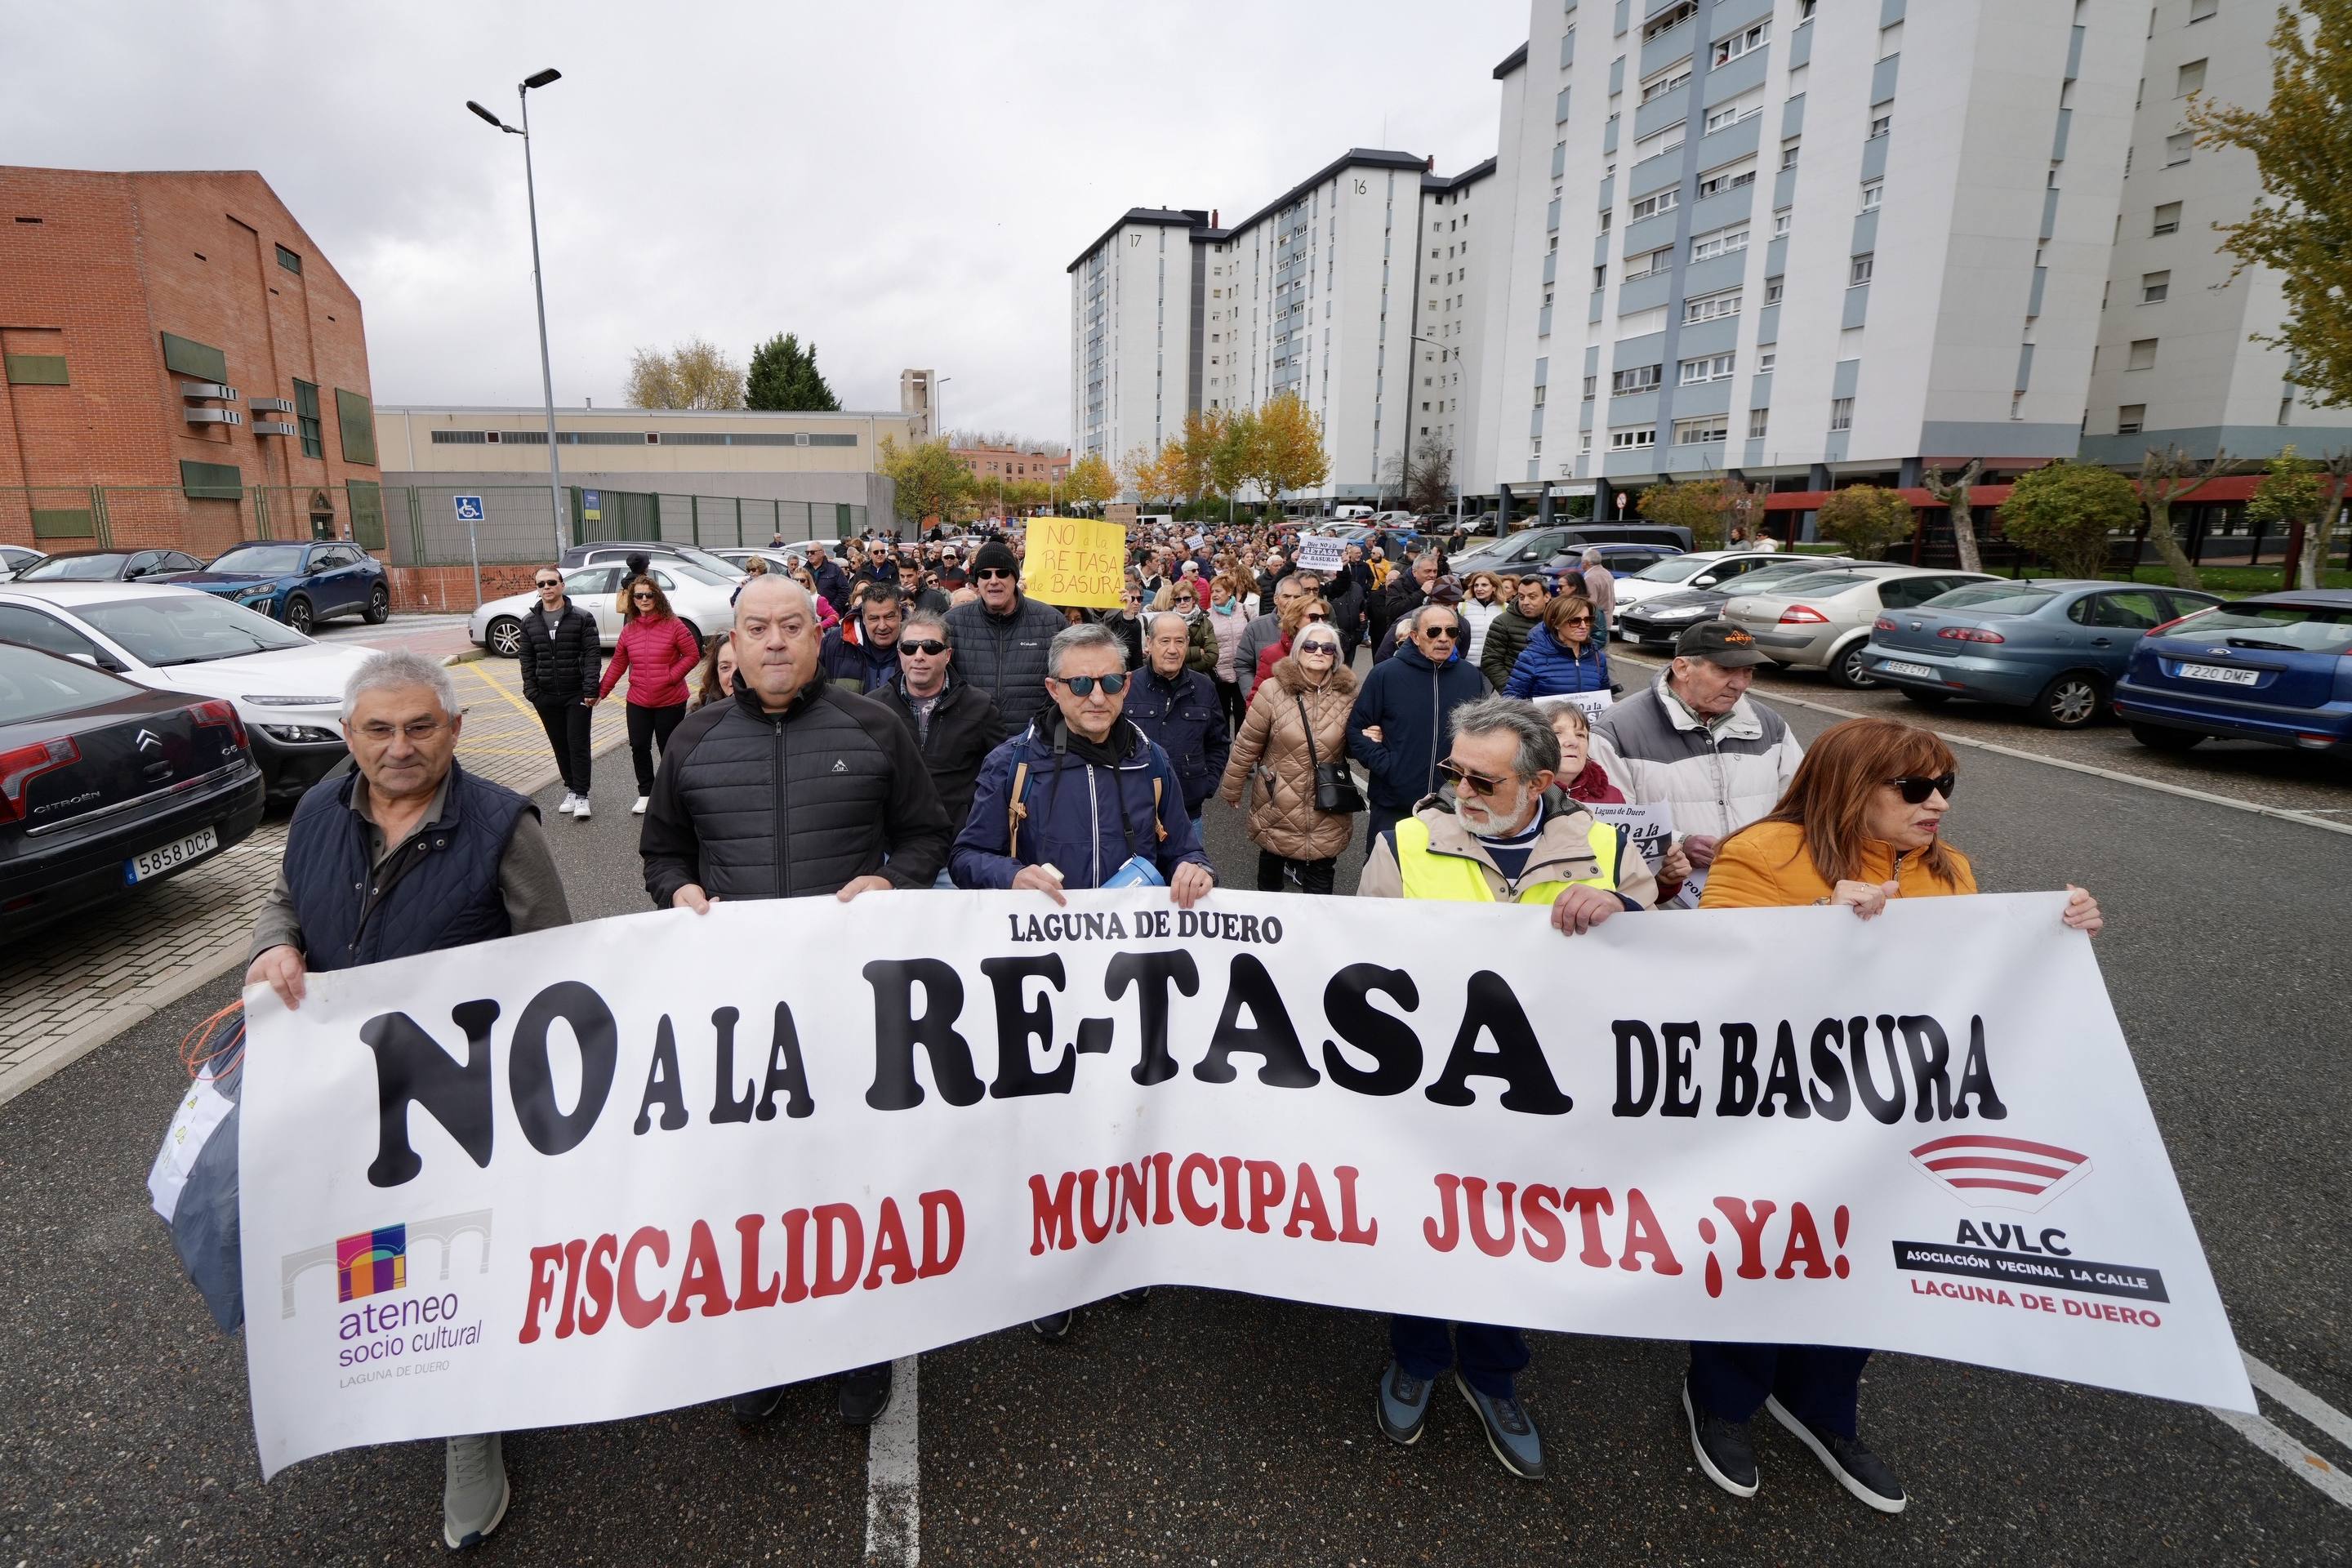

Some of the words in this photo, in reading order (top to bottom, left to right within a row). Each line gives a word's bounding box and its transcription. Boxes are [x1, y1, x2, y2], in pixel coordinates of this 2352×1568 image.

[1354, 179, 1366, 194] 16
[1130, 234, 1142, 247] 17
[1046, 525, 1076, 546] NO
[1083, 537, 1090, 546] a
[1095, 528, 1107, 549] la
[1303, 547, 1339, 556] RETASA
[1029, 575, 1044, 592] de
[1050, 574, 1121, 595] BASURA
[2183, 666, 2219, 679] 7220
[221, 745, 238, 755] C5
[1594, 807, 1616, 816] Laguna
[1626, 808, 1646, 816] Duero
[1633, 827, 1643, 838] a
[1646, 823, 1659, 837] la
[139, 844, 182, 875] 5858
[185, 831, 212, 857] DCP
[1009, 912, 1104, 942] LAGUNA
[1105, 911, 1154, 940] DE
[1154, 910, 1283, 944] DUERO
[359, 981, 617, 1188] NO
[633, 1013, 689, 1136] A
[709, 1000, 815, 1125] LA
[862, 948, 1574, 1116] RE-TASA
[1610, 1019, 1702, 1119] DE
[1715, 1013, 2007, 1125] BASURA
[519, 1189, 965, 1344] FISCALIDAD
[1028, 1152, 1379, 1256] MUNICIPAL
[1423, 1173, 1683, 1277] JUSTA
[1699, 1197, 1851, 1298] ¡YA!
[1956, 1218, 2072, 1257] AVLC
[1906, 1250, 1990, 1269] ASOCIACIÓN
[1996, 1260, 2065, 1279] VECINAL
[2069, 1268, 2093, 1282] LA
[2095, 1272, 2149, 1290] CALLE
[339, 1293, 458, 1340] ateneo
[1910, 1278, 2016, 1307] LAGUNA
[2019, 1292, 2057, 1313] DE
[2061, 1298, 2162, 1329] DUERO
[339, 1334, 403, 1367] socio
[412, 1319, 483, 1352] cultural
[340, 1368, 392, 1389] LAGUNA
[396, 1365, 412, 1378] DE
[414, 1360, 450, 1374] DUERO
